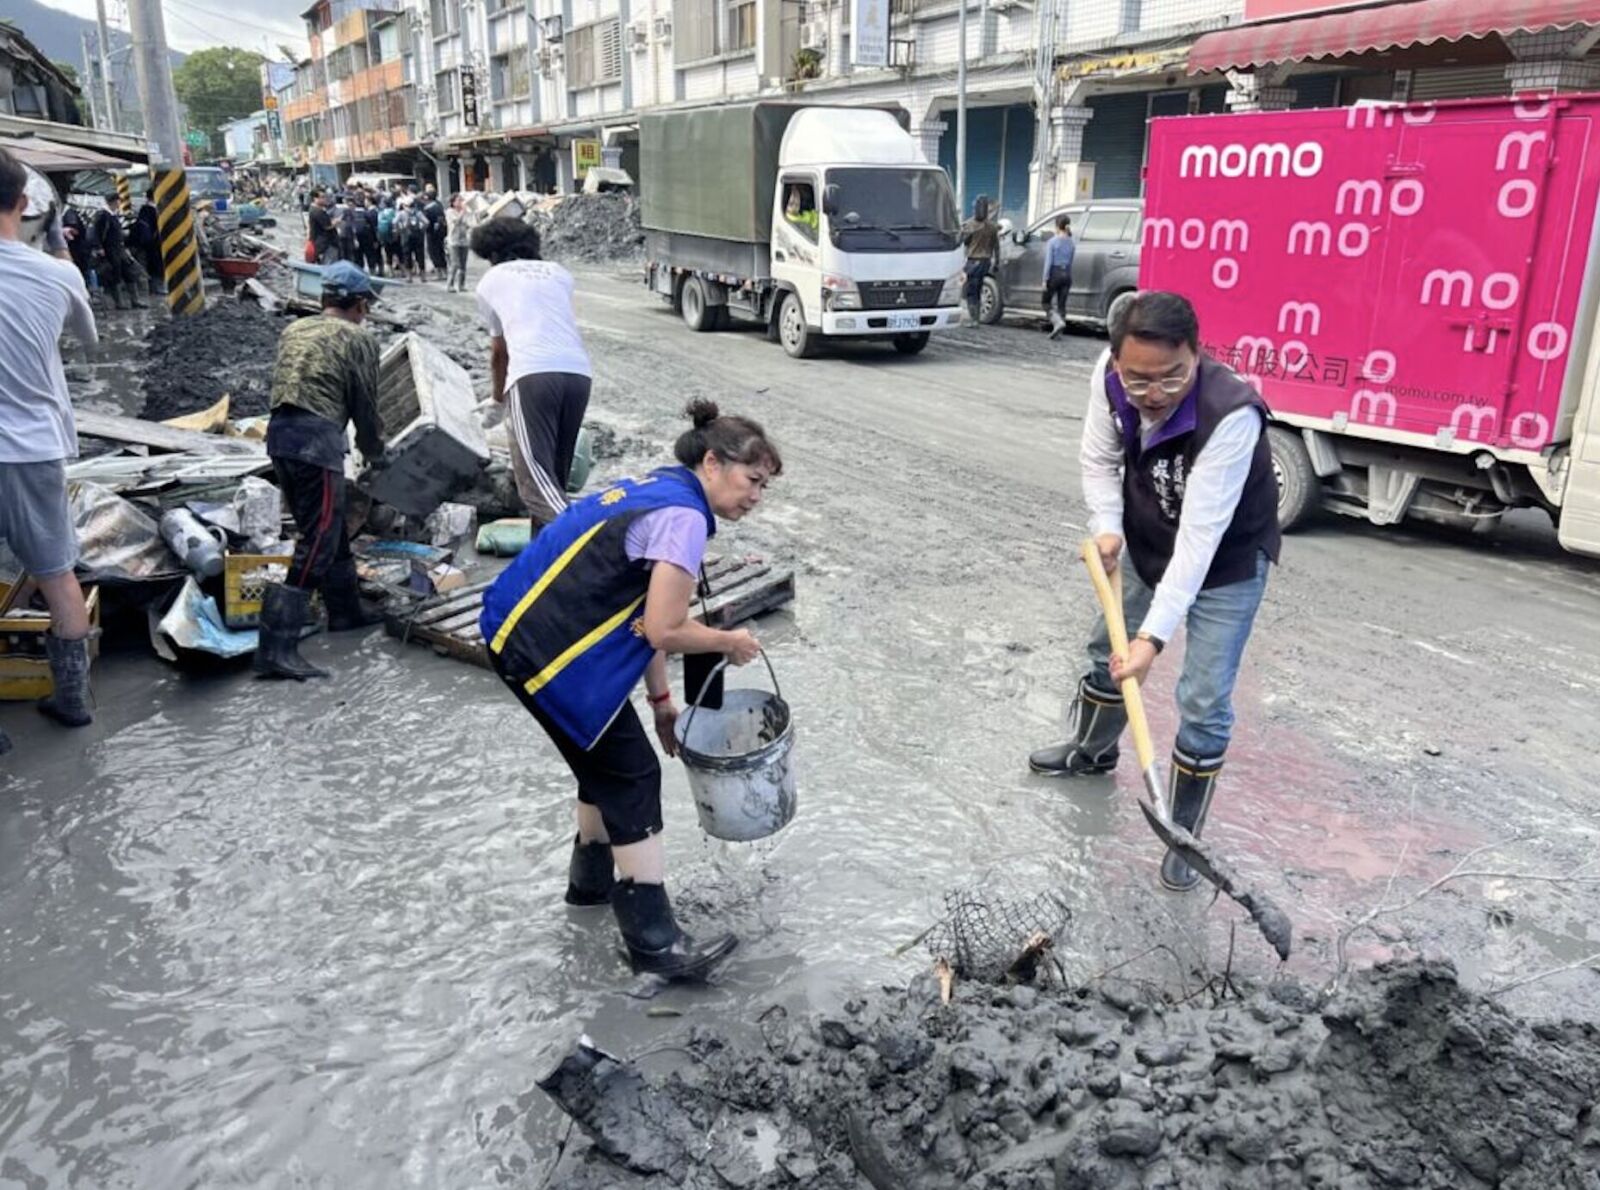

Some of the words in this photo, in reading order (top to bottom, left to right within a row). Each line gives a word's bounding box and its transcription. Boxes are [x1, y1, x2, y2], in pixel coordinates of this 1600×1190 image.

[1180, 141, 1324, 178] momo
[1335, 179, 1425, 217] mo
[1287, 220, 1371, 258] mo
[1420, 268, 1521, 310] mo
